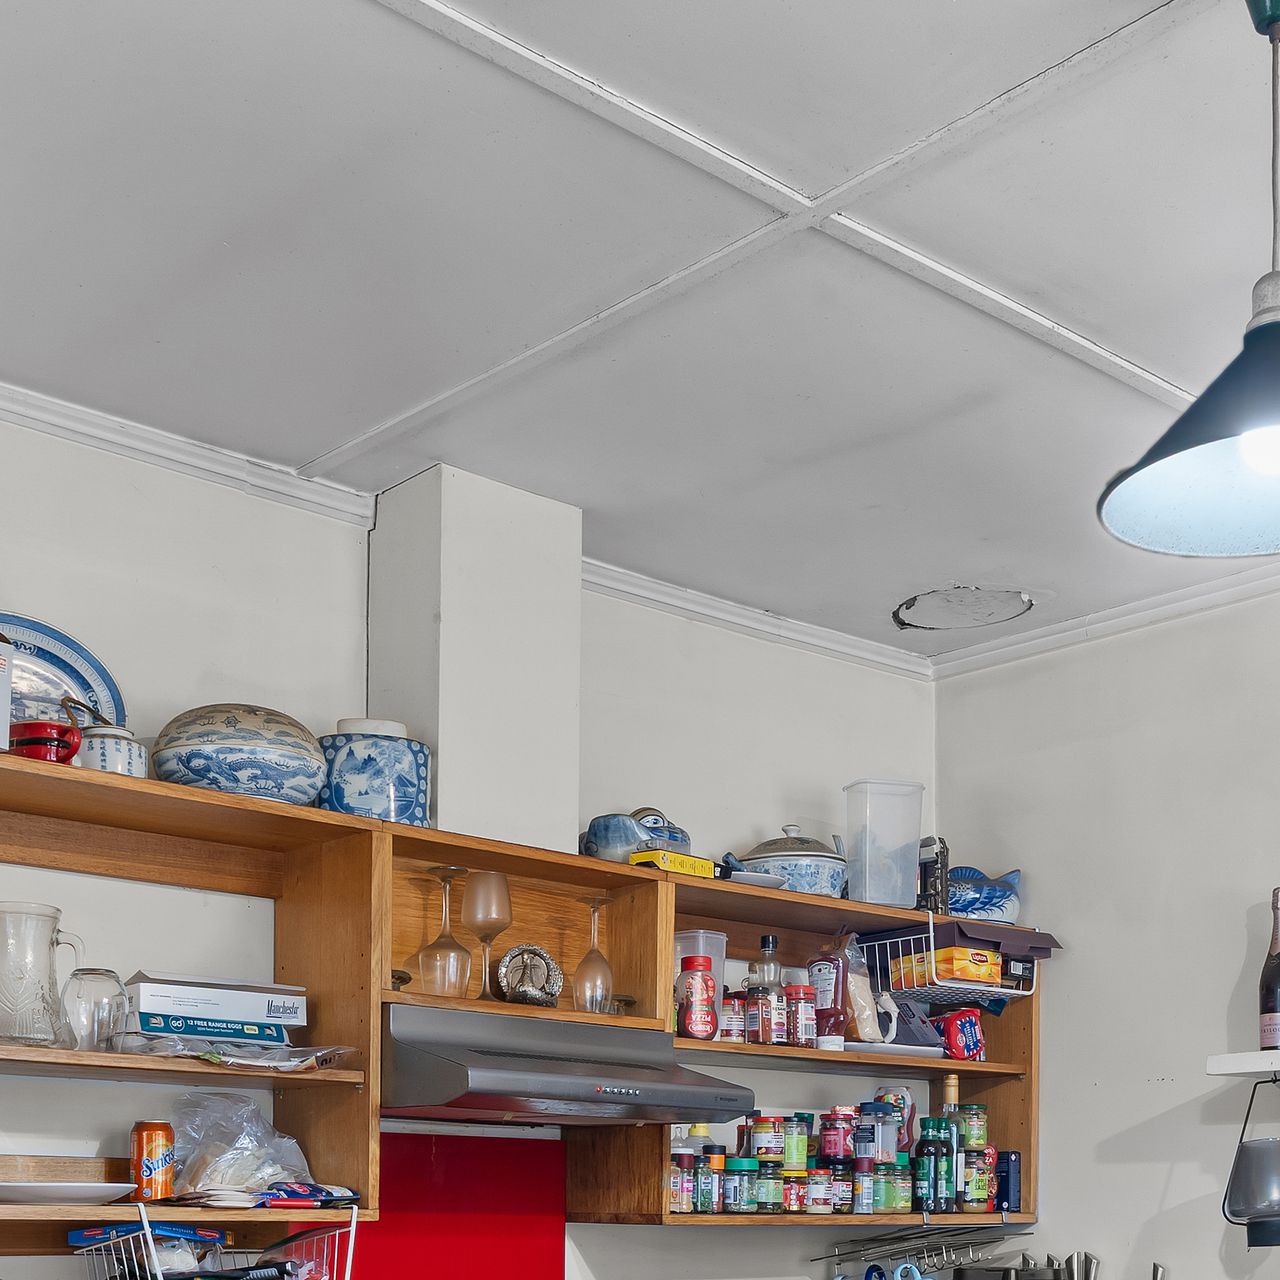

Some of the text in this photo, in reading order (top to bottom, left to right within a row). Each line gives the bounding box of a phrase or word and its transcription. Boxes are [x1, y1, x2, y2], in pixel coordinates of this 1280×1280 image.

[972, 953, 987, 961] Lipton
[691, 1014, 711, 1022] PIZZA
[208, 1022, 228, 1030] RANGE
[141, 1145, 176, 1178] Sunkis
